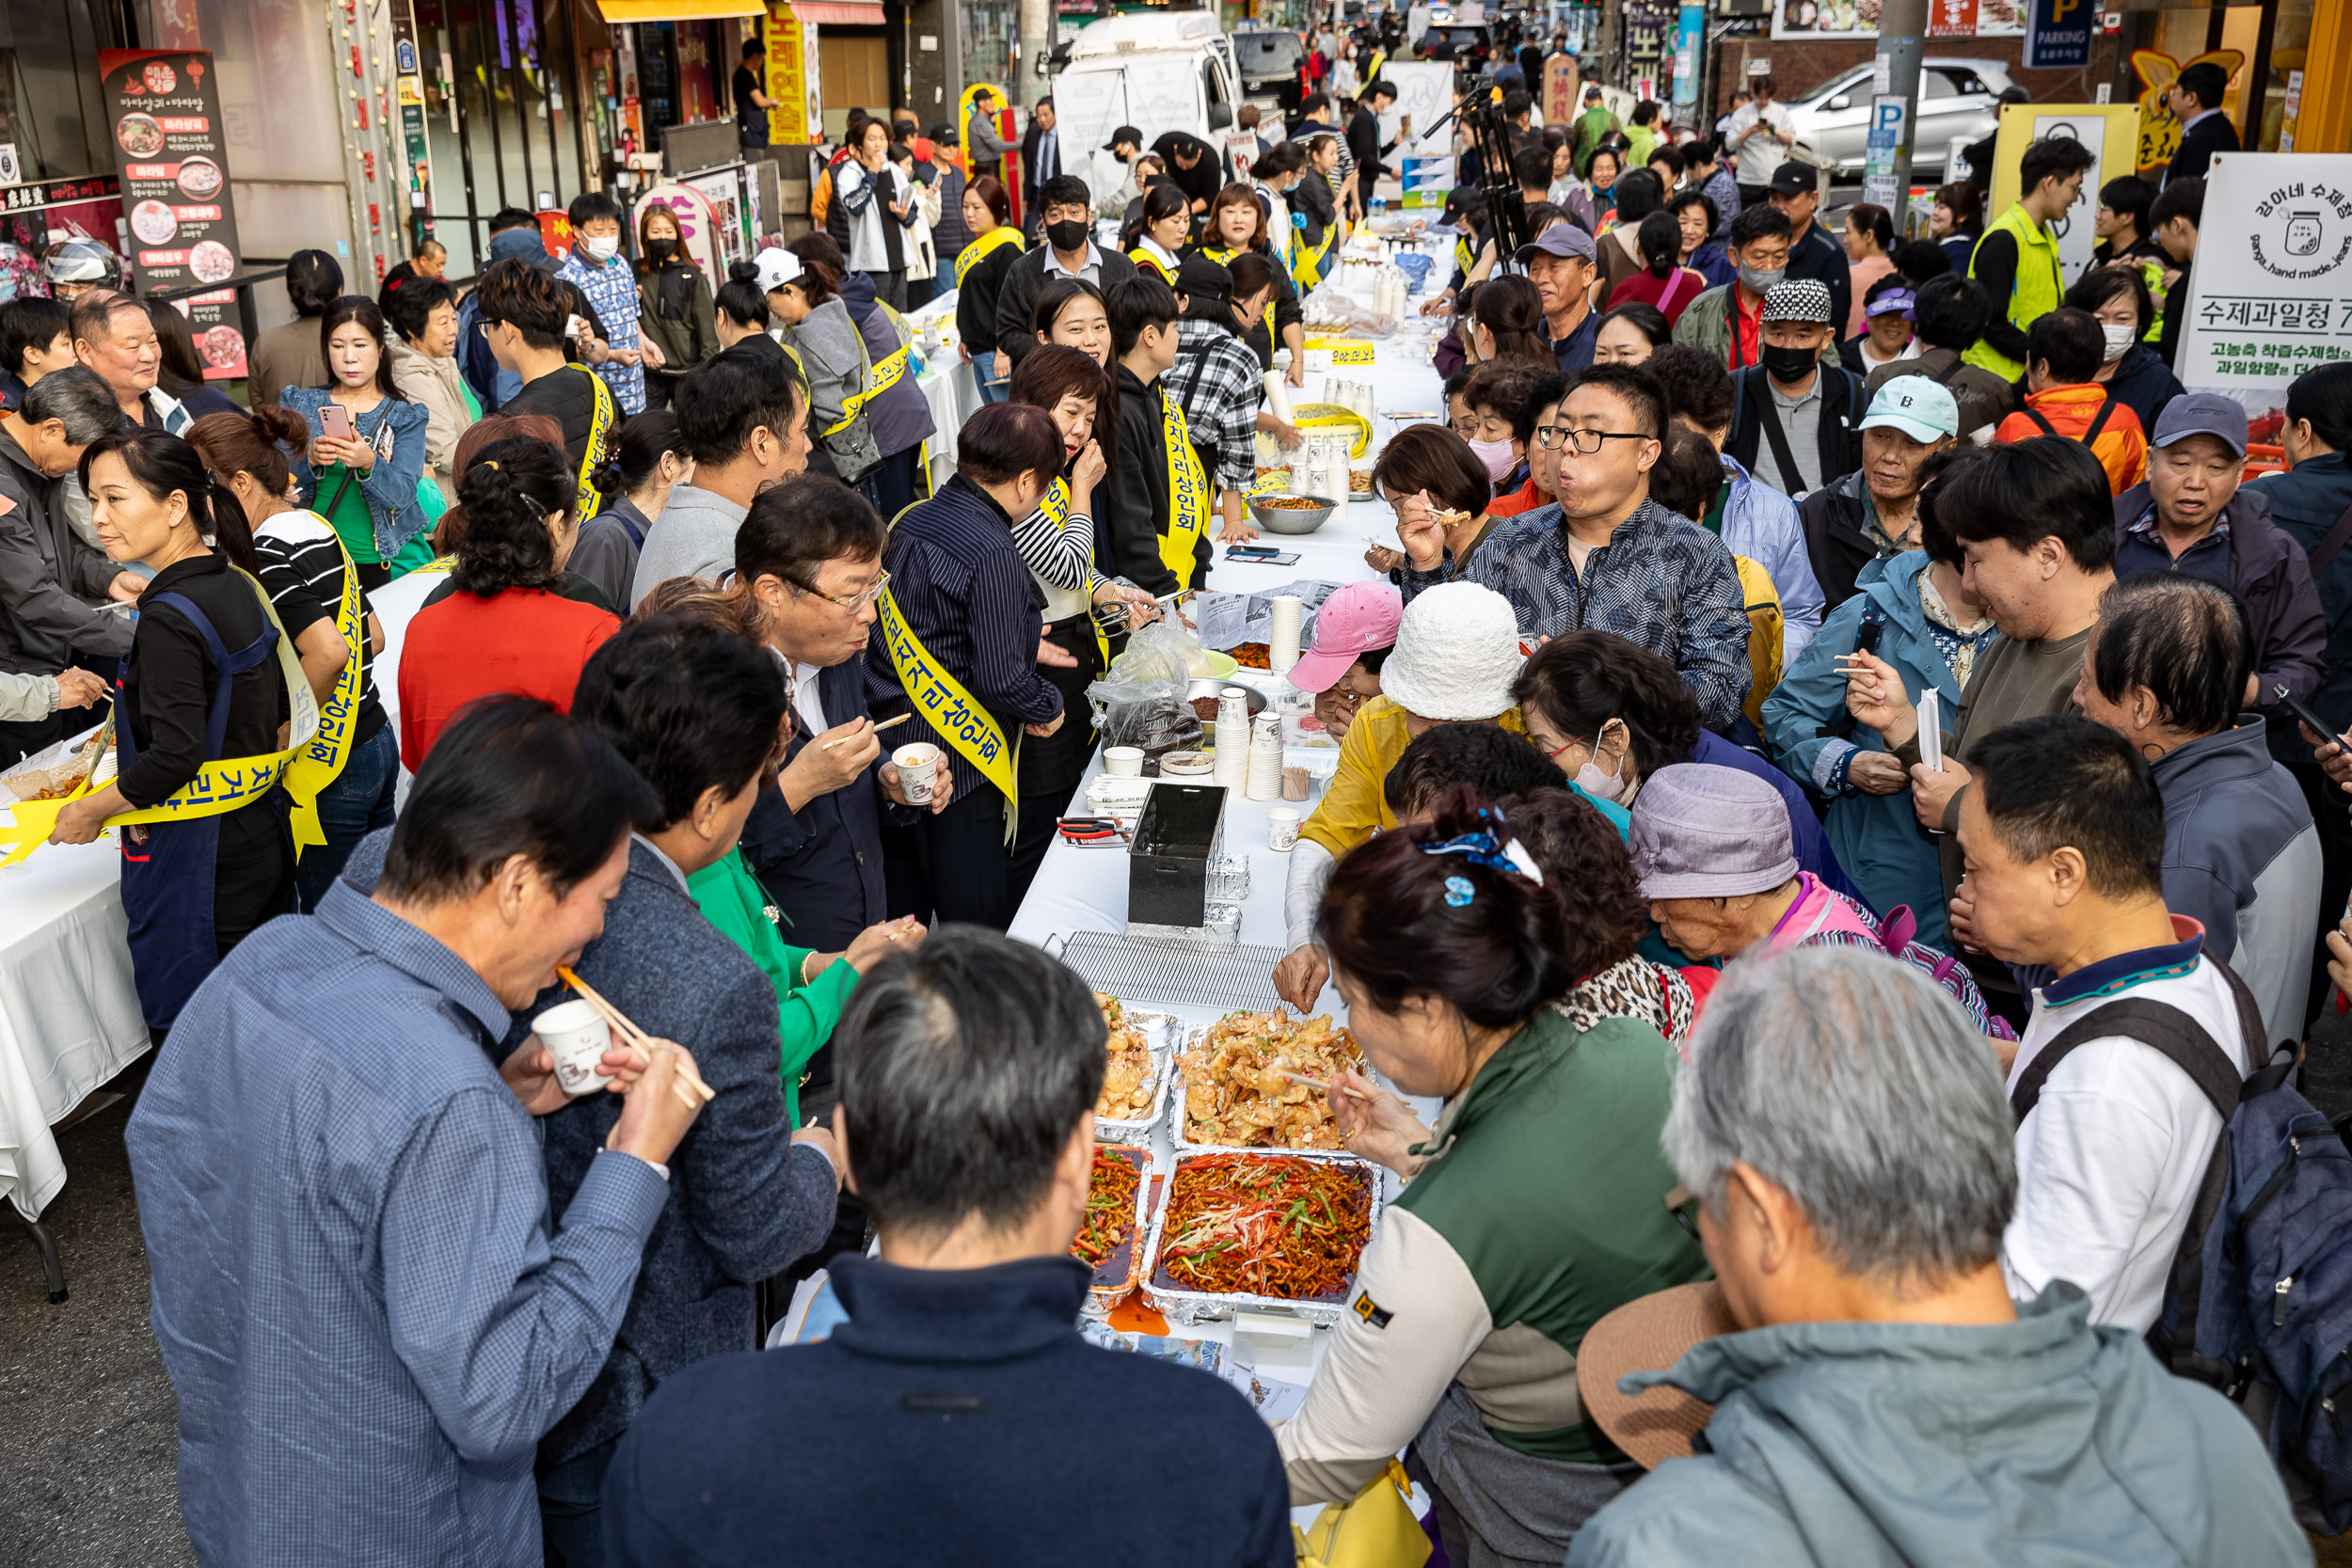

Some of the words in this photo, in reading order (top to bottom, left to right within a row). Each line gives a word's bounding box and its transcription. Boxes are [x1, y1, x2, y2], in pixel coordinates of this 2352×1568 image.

[2038, 30, 2086, 45] PARKING
[1879, 105, 1902, 130] P
[2255, 182, 2305, 217] 강아네
[2311, 183, 2352, 219] 수제청
[2201, 301, 2330, 328] 수제과일청
[2211, 342, 2257, 357] 고농축
[879, 576, 1002, 766] 양꼬치거리상인회
